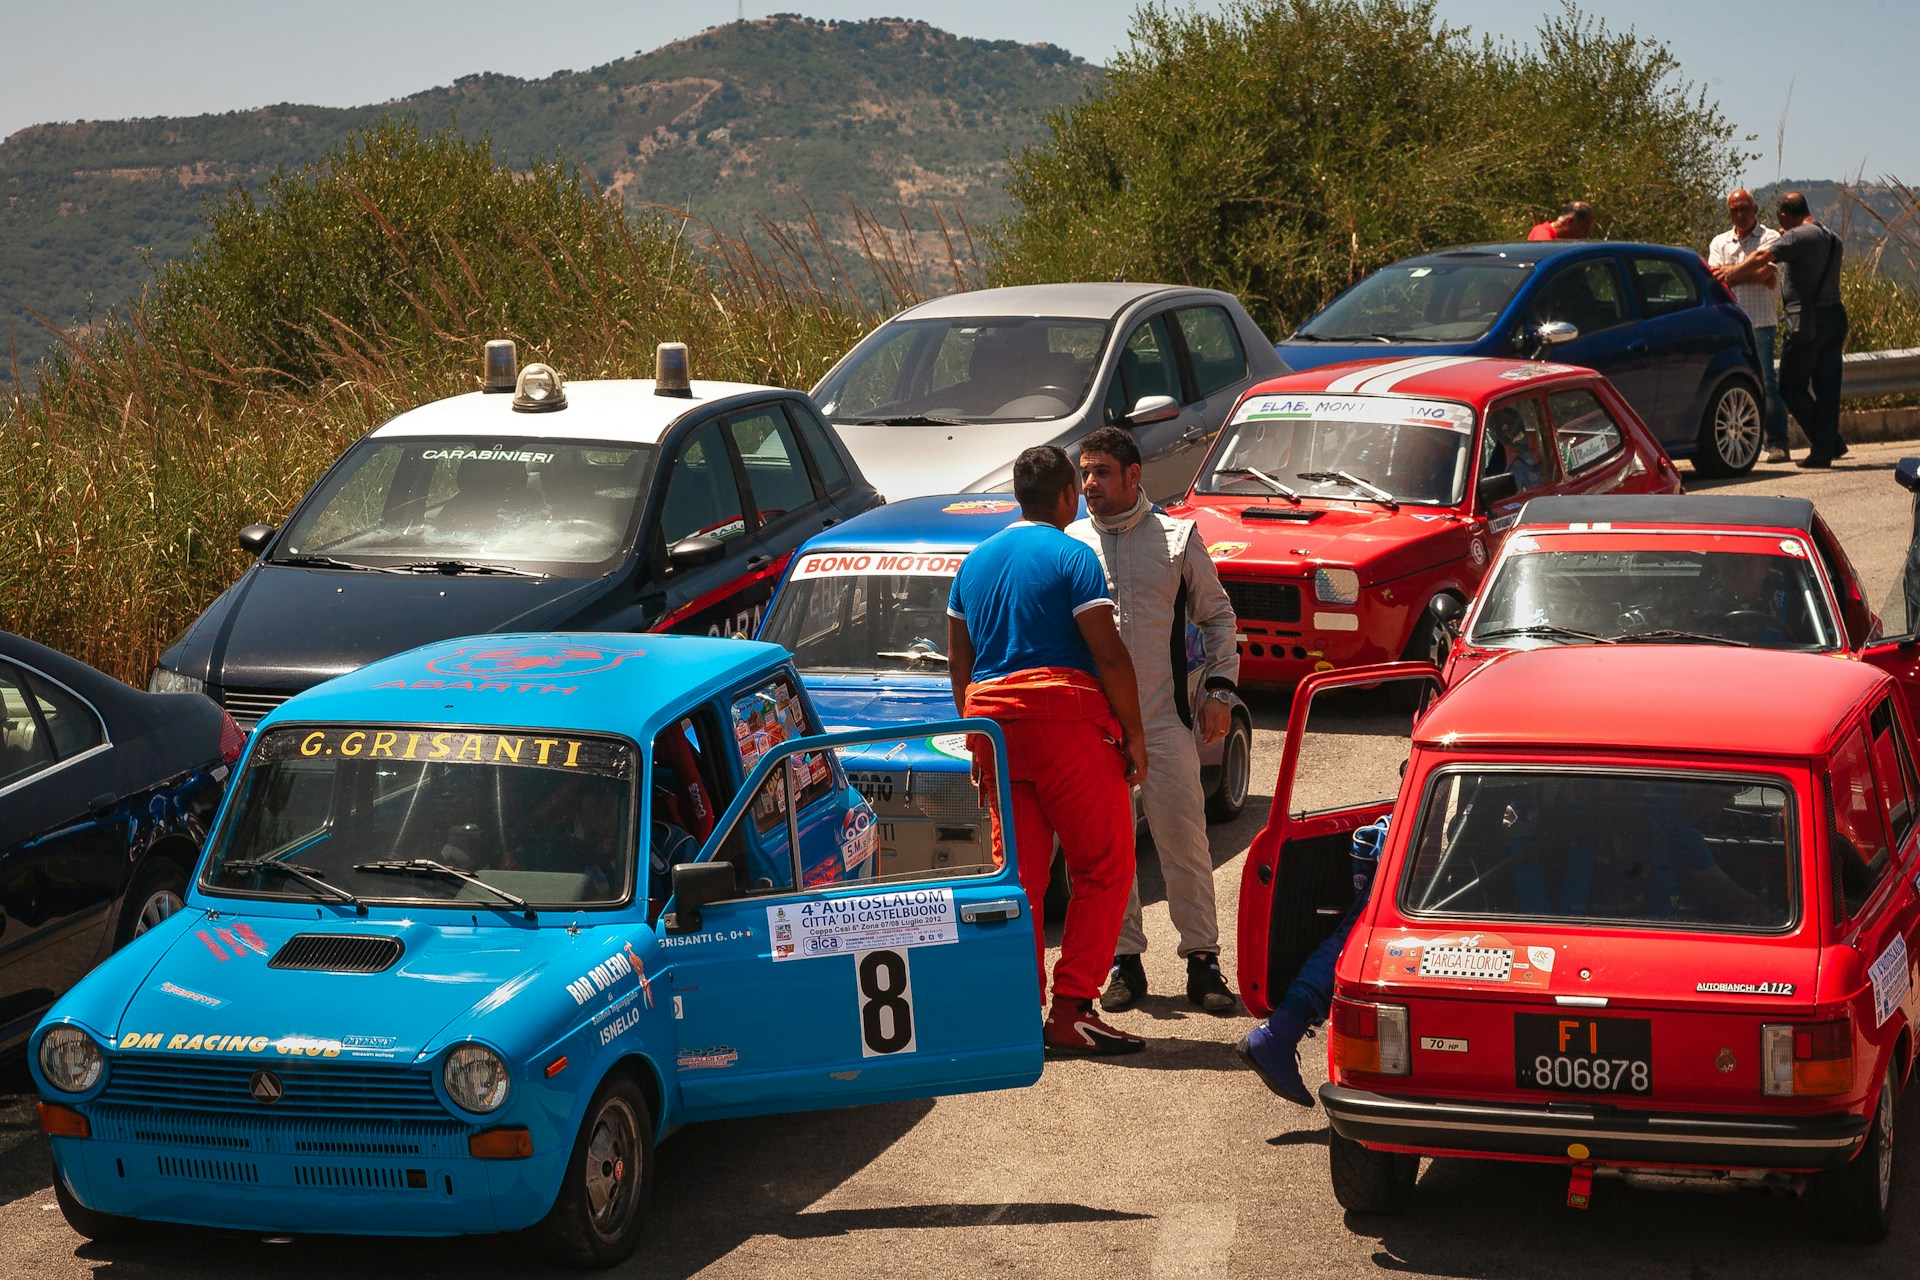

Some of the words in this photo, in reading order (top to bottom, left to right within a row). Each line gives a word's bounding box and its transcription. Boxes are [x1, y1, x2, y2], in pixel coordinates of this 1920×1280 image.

[1260, 401, 1309, 412] ELAB.
[422, 450, 556, 463] CARABINIERI
[804, 556, 871, 574] BONO
[876, 556, 962, 573] MOTOR
[371, 679, 580, 695] ABARTH
[842, 913, 855, 924] DI
[858, 904, 947, 922] CASTELBUONO
[810, 927, 833, 936] Coppa
[861, 922, 880, 930] Zona
[880, 920, 900, 928] 07/08
[901, 918, 924, 928] Luglio
[925, 916, 942, 924] 2012
[658, 933, 712, 948] GRISANTI
[716, 932, 728, 941] G.
[810, 935, 838, 950] alca
[1430, 953, 1462, 968] TARGA
[1464, 955, 1503, 970] FLORIO
[565, 976, 597, 1006] BAR
[588, 952, 632, 992] BOLERO
[1696, 982, 1755, 992] AUTOBIANCHI
[1758, 982, 1793, 995] A112
[859, 950, 912, 1054] 8
[600, 1007, 640, 1046] ISNELLO
[119, 1032, 164, 1049] DM
[167, 1034, 271, 1053] RACING
[275, 1037, 343, 1058] CLUB
[1429, 1039, 1444, 1049] 70
[1535, 1055, 1649, 1091] 806878
